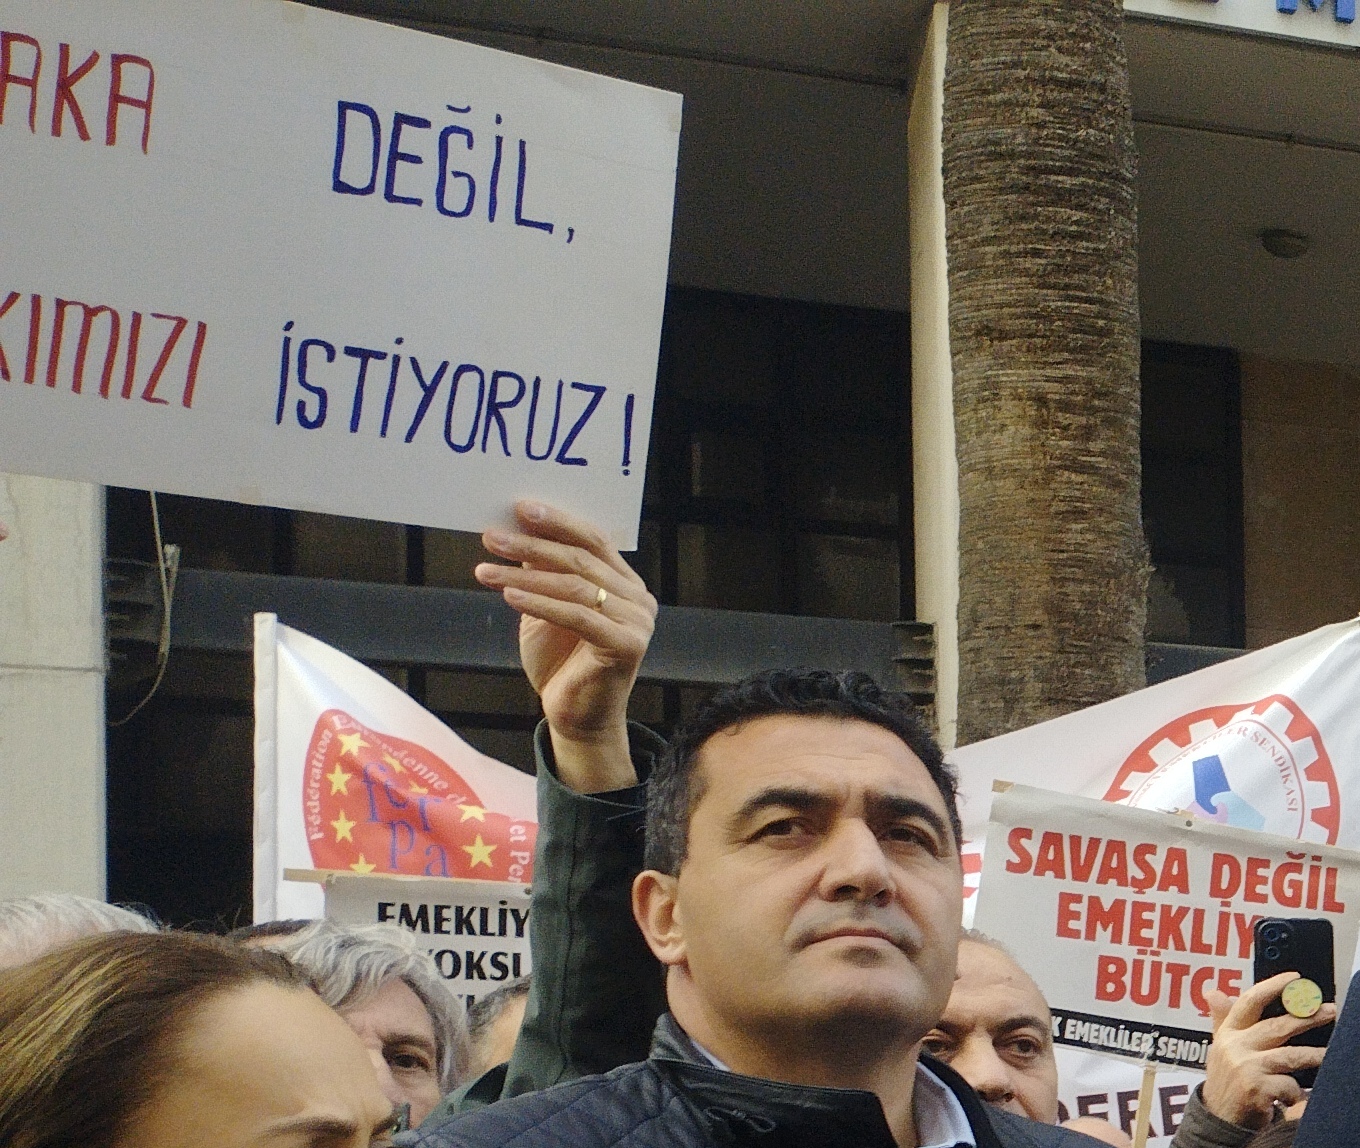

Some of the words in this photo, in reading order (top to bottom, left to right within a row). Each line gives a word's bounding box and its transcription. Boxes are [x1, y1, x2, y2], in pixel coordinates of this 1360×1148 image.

[331, 99, 576, 244] DEĞİL,
[1250, 730, 1298, 812] SENDİKASI
[1005, 827, 1190, 896] SAVAŞA
[1209, 850, 1347, 914] DEĞİL
